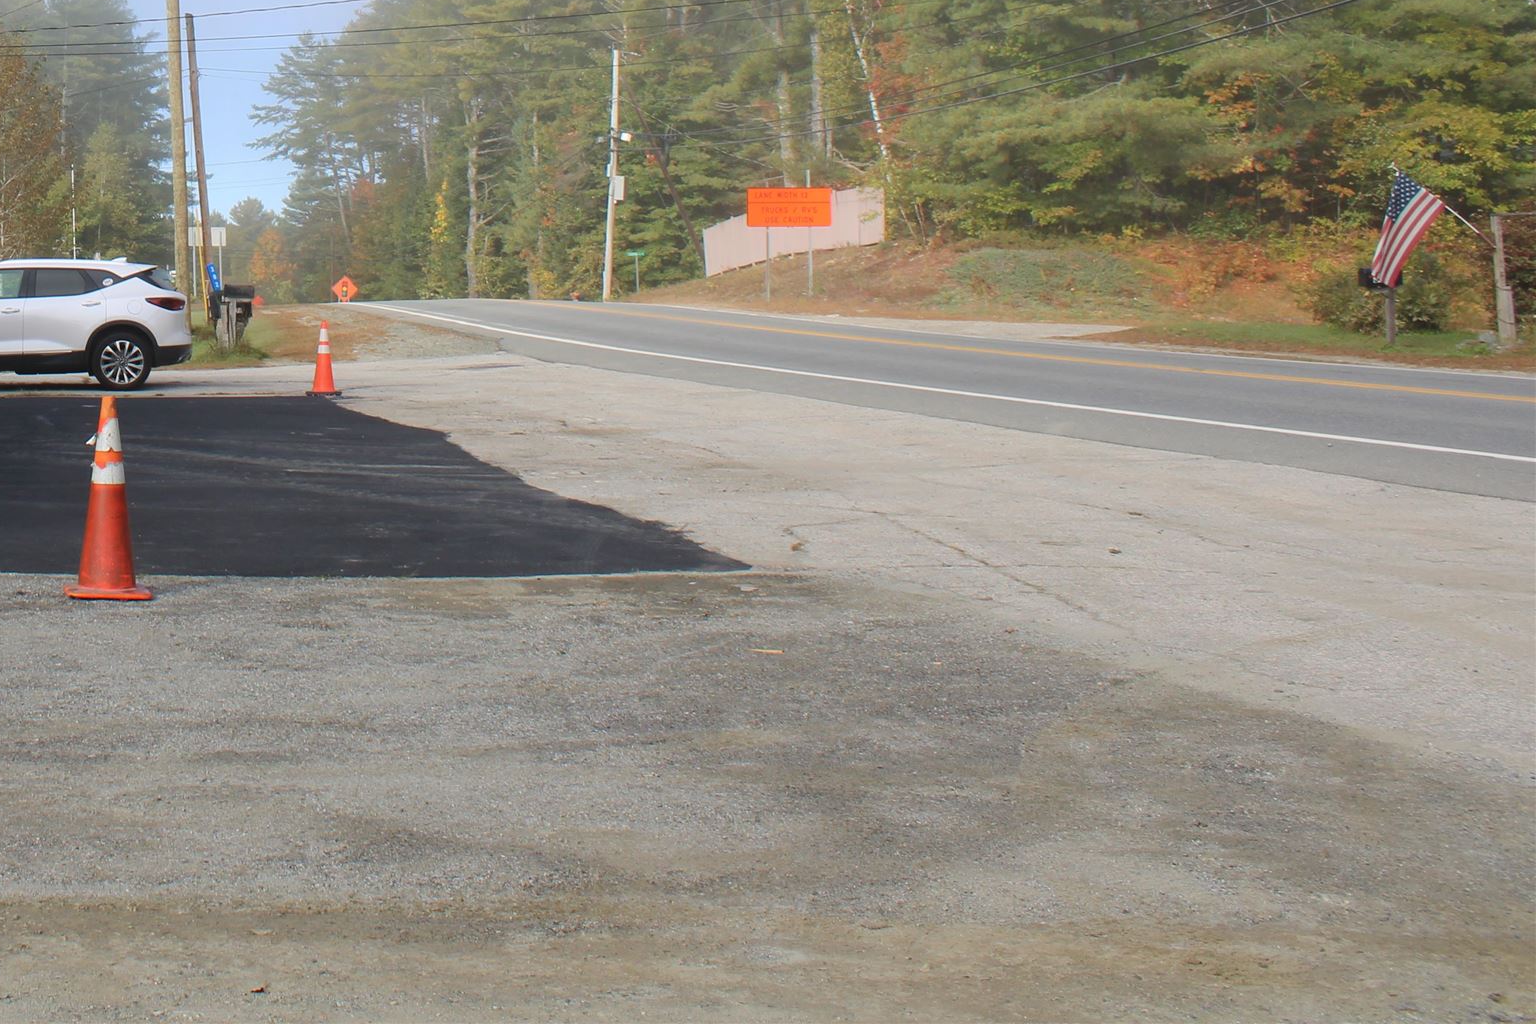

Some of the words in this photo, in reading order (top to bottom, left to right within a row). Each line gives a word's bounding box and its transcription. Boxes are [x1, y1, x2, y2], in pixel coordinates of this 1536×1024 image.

[761, 206, 789, 214] TRUCKS
[764, 216, 778, 224] USE
[782, 216, 815, 224] CAUTION
